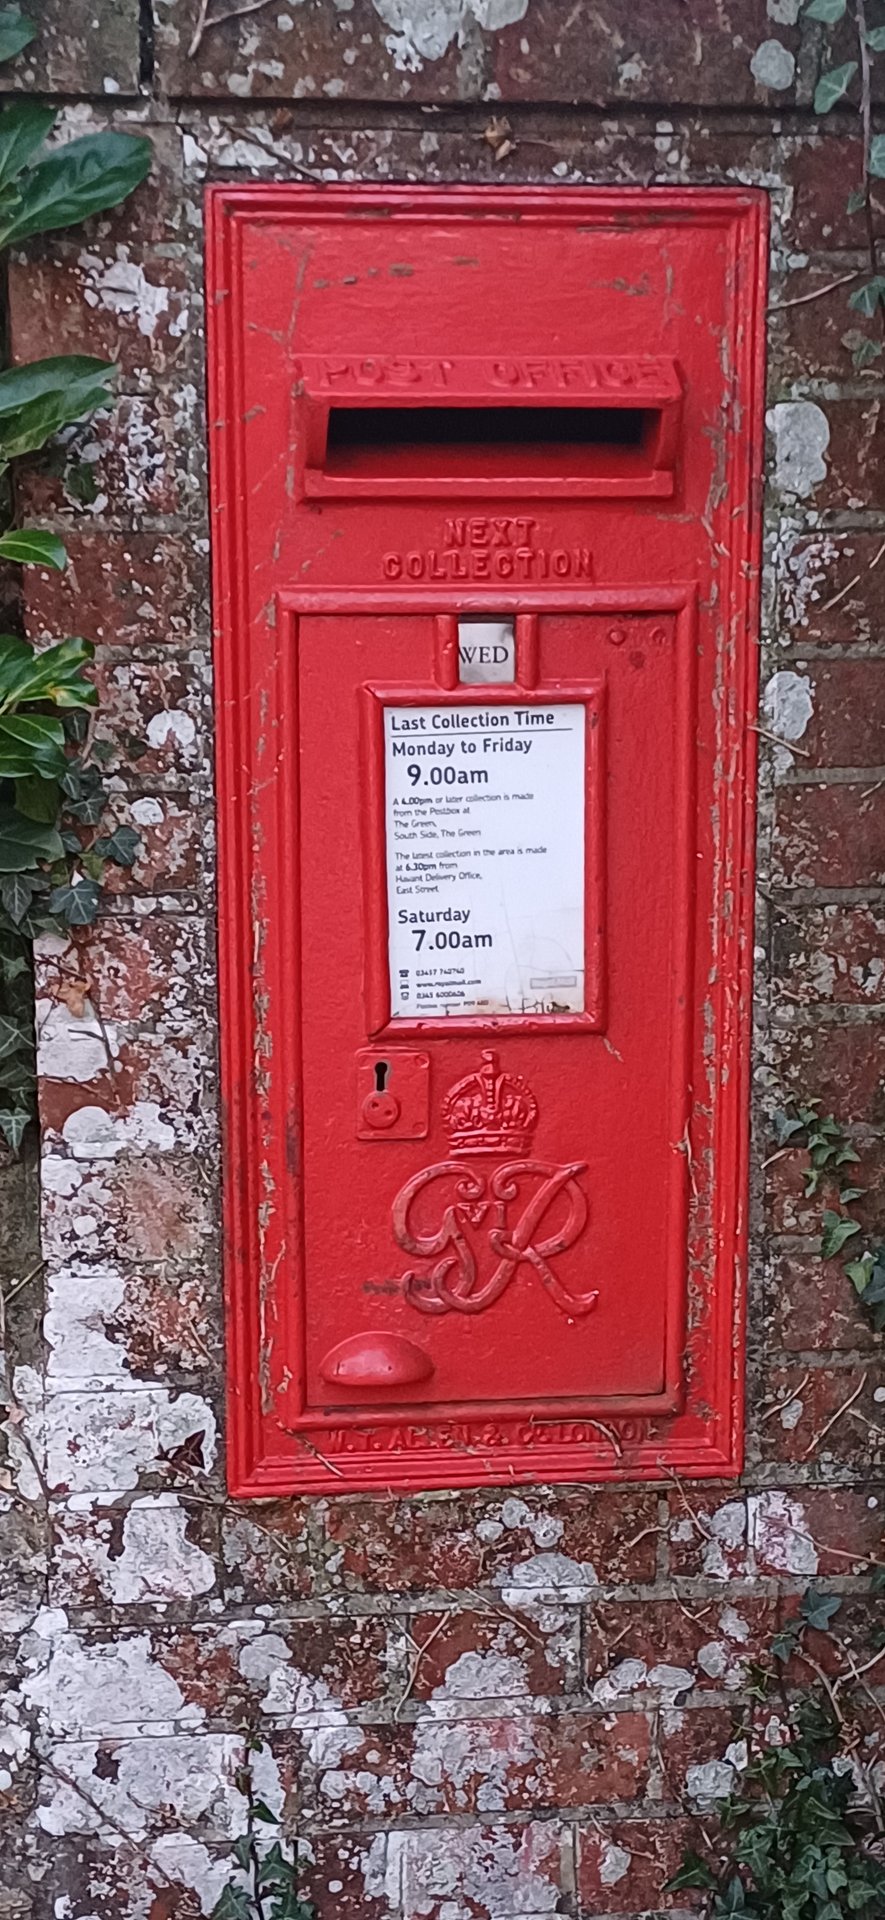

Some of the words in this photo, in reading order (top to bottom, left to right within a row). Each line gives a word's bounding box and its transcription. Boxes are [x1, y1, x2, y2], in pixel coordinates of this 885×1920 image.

[320, 360, 453, 388] POST
[484, 359, 671, 389] OFFICE
[444, 516, 537, 548] NEXT
[382, 547, 596, 580] COLLECTION
[458, 646, 509, 665] WED
[391, 716, 426, 731] Last
[432, 712, 510, 729] Collection
[514, 710, 554, 726] Time
[392, 740, 455, 757] Monday
[460, 740, 477, 754] to
[483, 737, 533, 754] Friday
[406, 763, 489, 787] 9.00am
[392, 798, 400, 806] A
[435, 796, 444, 804] or
[445, 795, 463, 804] later
[465, 793, 502, 803] collection
[503, 792, 510, 801] is
[512, 792, 534, 800] made
[393, 808, 412, 817] from
[414, 807, 427, 816] the
[429, 806, 460, 816] Postbox
[462, 806, 471, 814] at
[394, 819, 409, 828] The
[394, 831, 418, 840] South
[440, 829, 455, 837] The
[458, 828, 482, 837] Green
[395, 852, 410, 860] The
[412, 851, 434, 860] latest
[436, 850, 471, 859] collection
[473, 849, 481, 857] in
[483, 848, 496, 857] the
[498, 848, 515, 856] area
[517, 846, 523, 855] is
[525, 846, 547, 854] made
[395, 864, 403, 872] at
[405, 862, 437, 872] 6.30pm
[438, 861, 458, 869] from
[395, 874, 424, 883] Havant
[425, 873, 456, 883] Delivery
[396, 886, 413, 894] East
[415, 885, 439, 894] Street
[397, 907, 471, 924] Saturday
[411, 929, 493, 952] 7.00am
